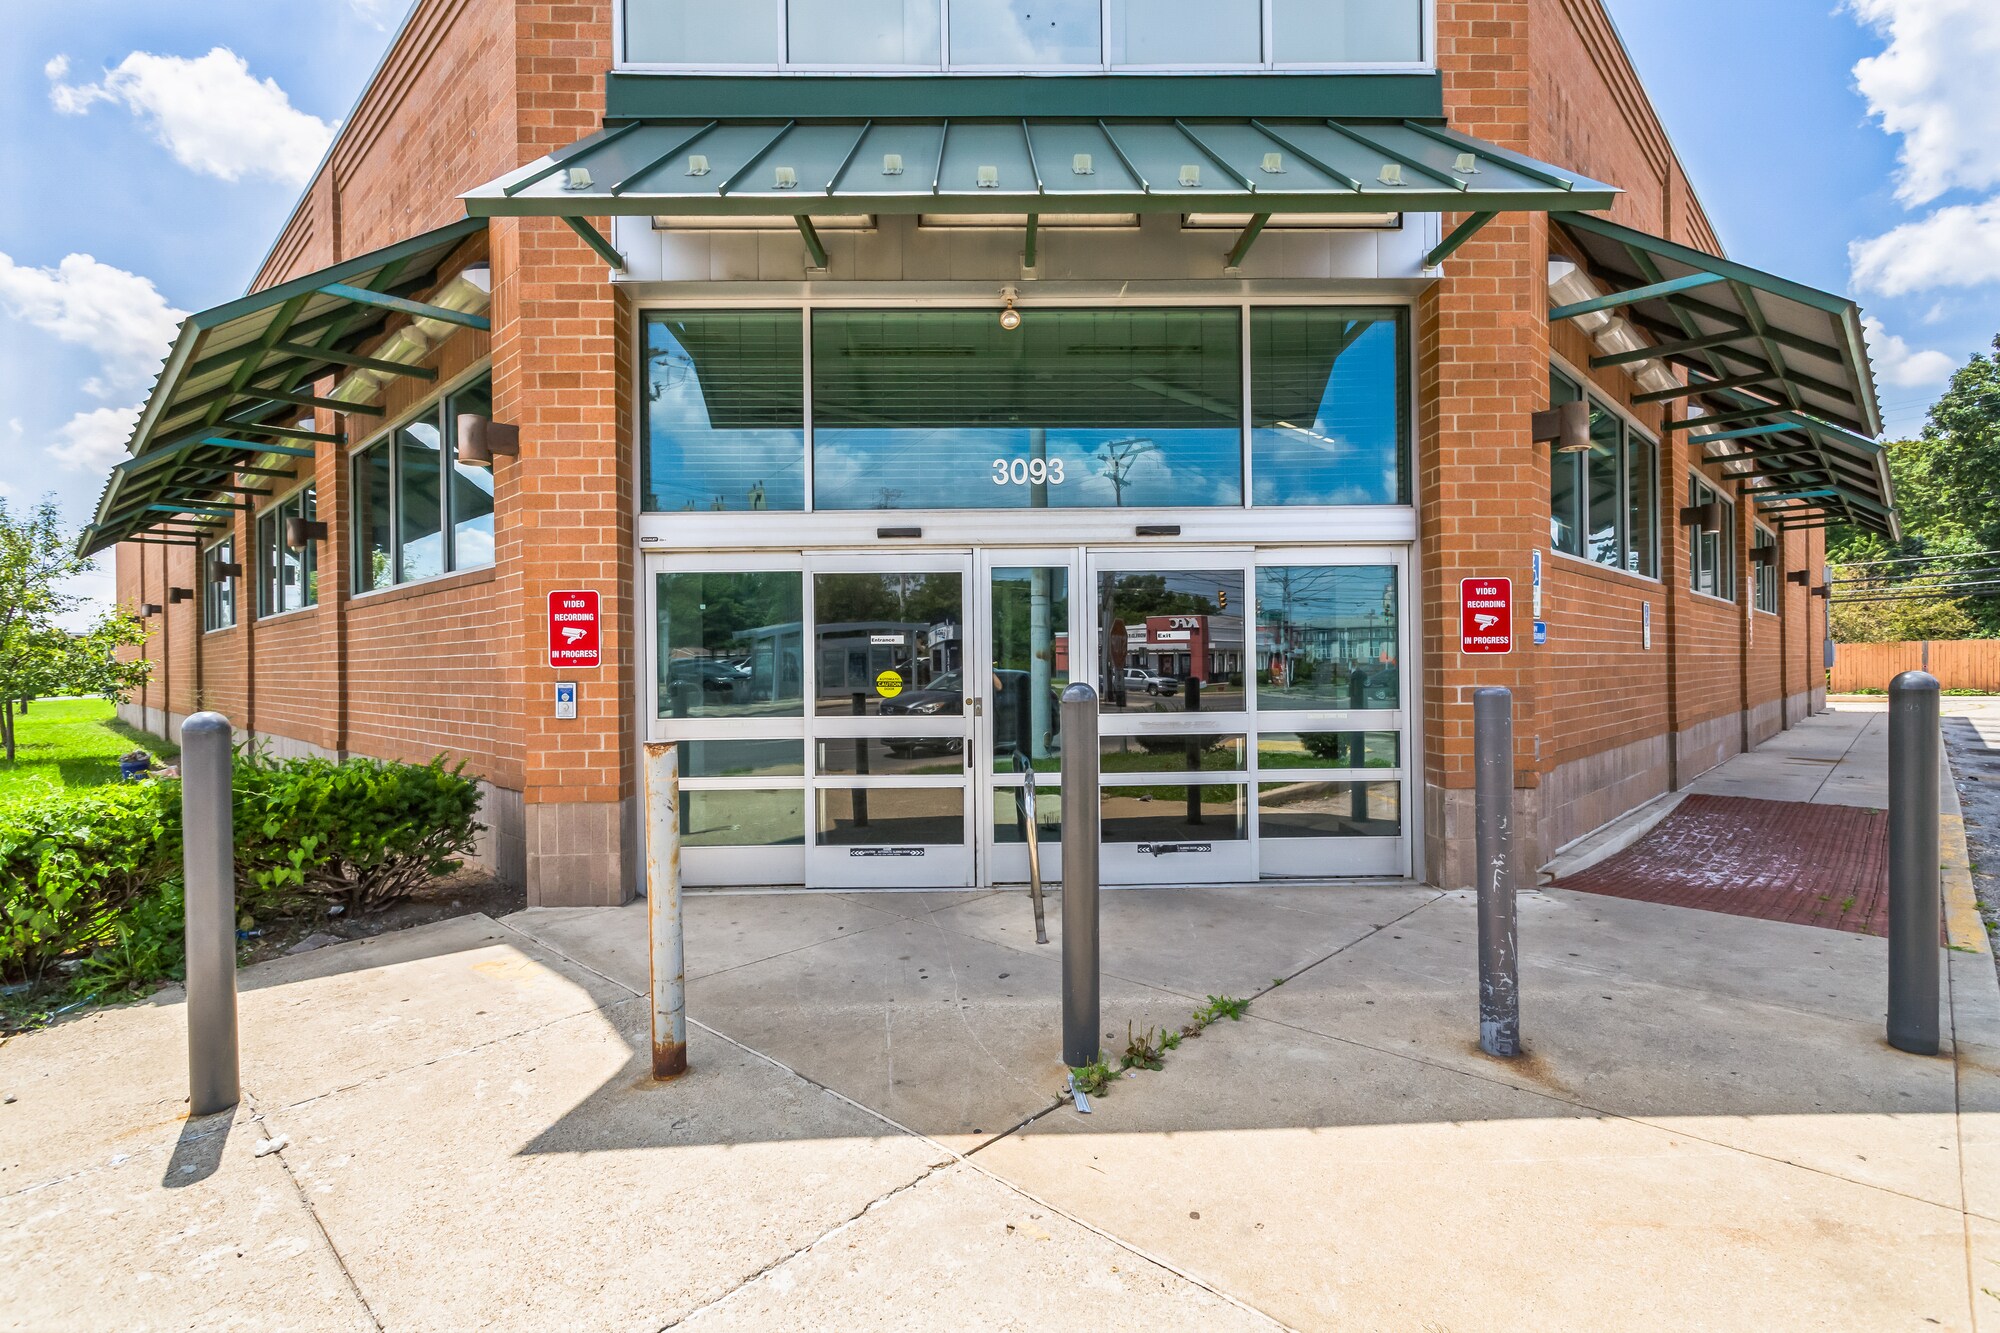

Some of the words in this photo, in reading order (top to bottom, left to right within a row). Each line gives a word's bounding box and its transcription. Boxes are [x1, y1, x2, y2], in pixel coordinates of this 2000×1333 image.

[992, 458, 1065, 485] 3093
[1475, 587, 1497, 595] VIDEO
[563, 600, 585, 608] VIDEO
[1467, 600, 1506, 608] RECORDING
[554, 613, 594, 621] RECORDING
[1473, 636, 1509, 644] PROGRESS
[551, 650, 560, 658] IN
[561, 650, 598, 658] PROGRESS
